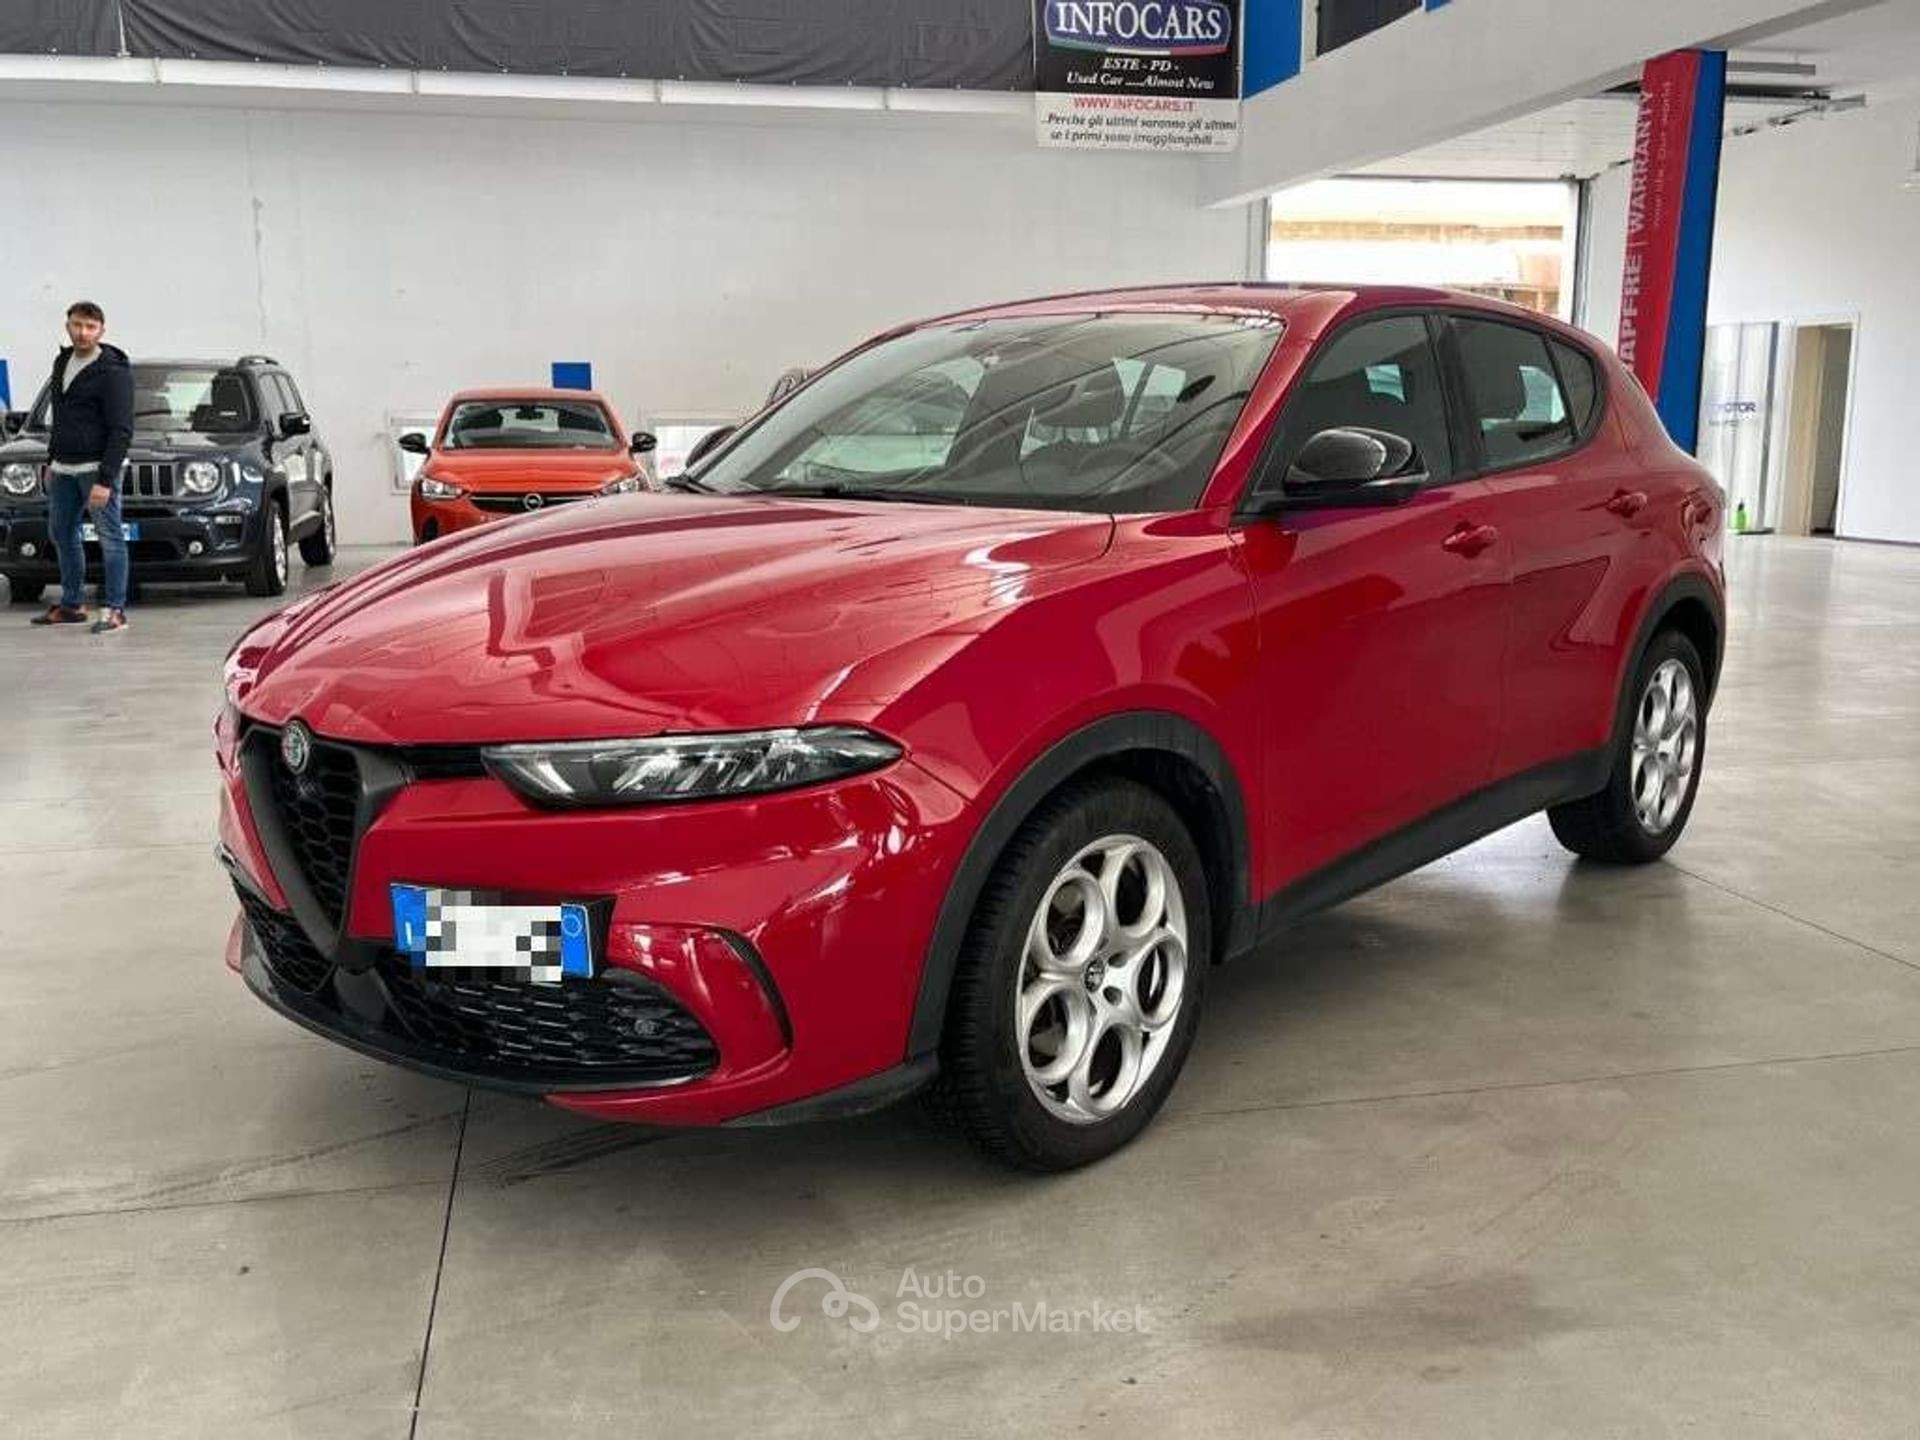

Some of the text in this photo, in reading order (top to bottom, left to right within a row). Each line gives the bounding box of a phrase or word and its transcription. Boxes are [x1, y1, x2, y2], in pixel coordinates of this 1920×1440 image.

[1055, 2, 1222, 39] INFOCARS
[1103, 58, 1140, 70] ESTE
[1150, 60, 1172, 72] PD
[1066, 71, 1098, 84] Used
[1100, 73, 1124, 85] Car
[1187, 76, 1215, 89] New
[1073, 97, 1196, 112] WWW.INFOCARS.IT
[1629, 89, 1654, 234] WARRANTY
